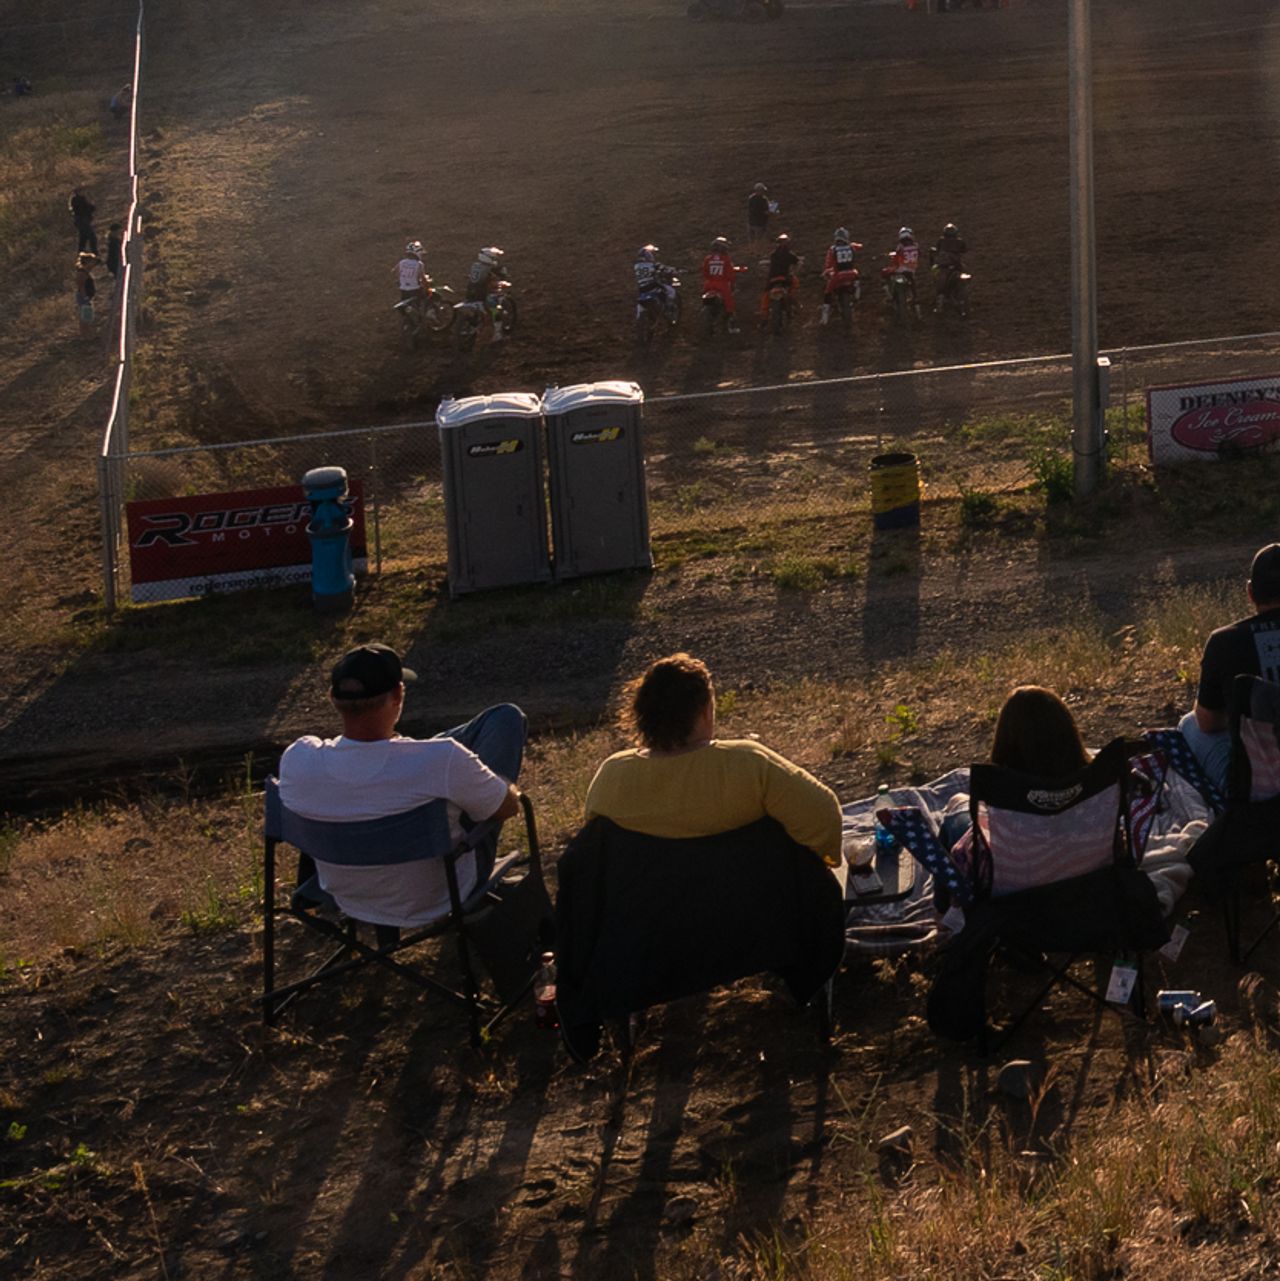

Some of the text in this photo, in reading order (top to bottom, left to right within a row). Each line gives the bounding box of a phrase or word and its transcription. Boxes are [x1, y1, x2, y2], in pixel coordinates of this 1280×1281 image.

[1188, 407, 1280, 432] Ice Cream
[211, 524, 298, 543] MOTO
[190, 569, 313, 595] rogersmotors.com
